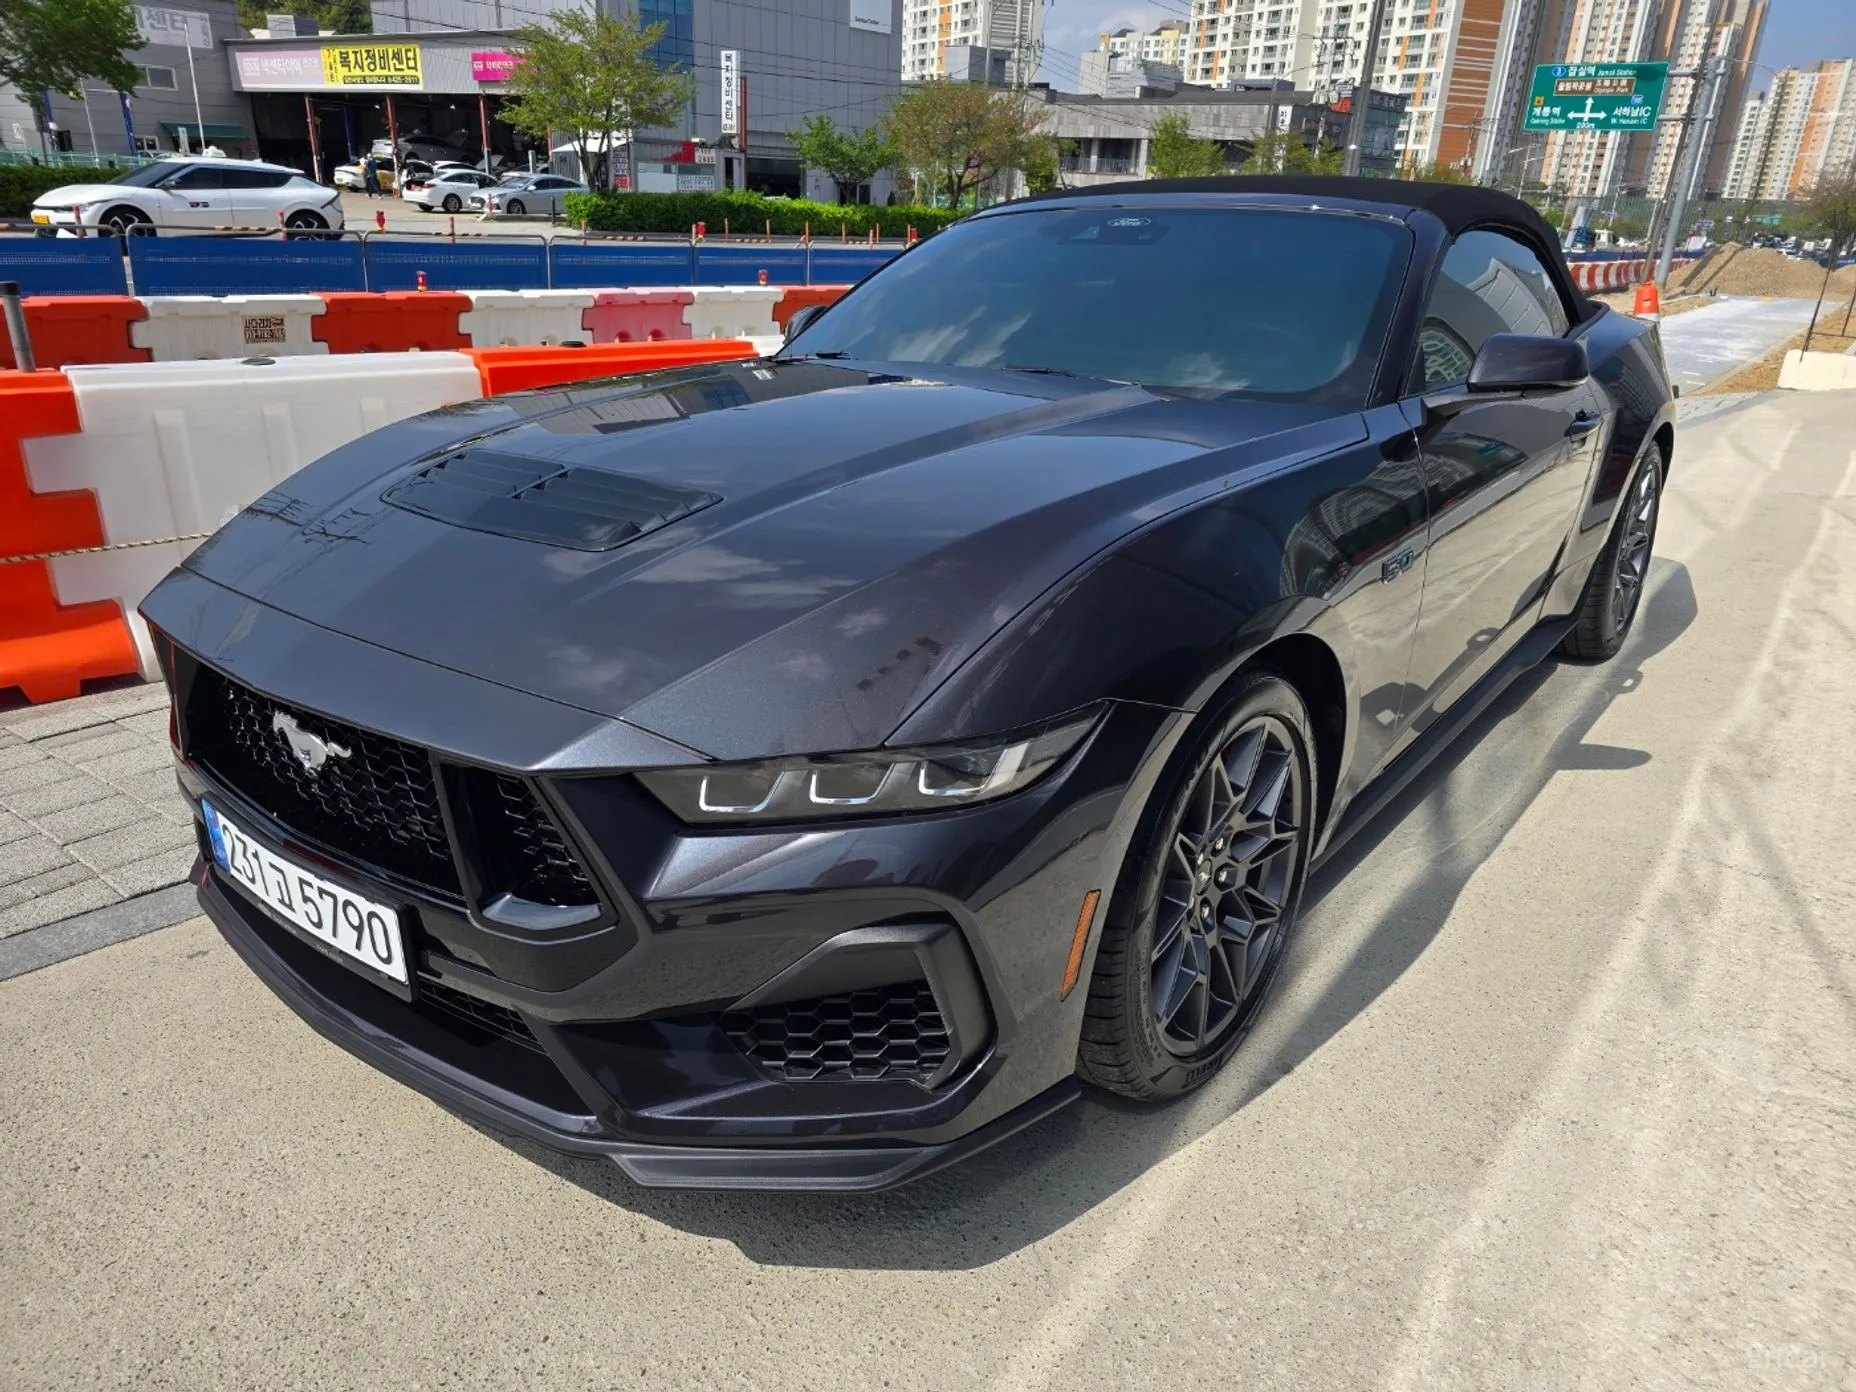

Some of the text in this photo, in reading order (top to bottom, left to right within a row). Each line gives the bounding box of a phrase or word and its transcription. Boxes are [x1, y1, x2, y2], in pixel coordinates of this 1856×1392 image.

[339, 48, 418, 72] 복지정비센터
[1568, 66, 1596, 76] 잠실역
[1616, 67, 1637, 76] Station
[1612, 106, 1652, 117] 서하남IC
